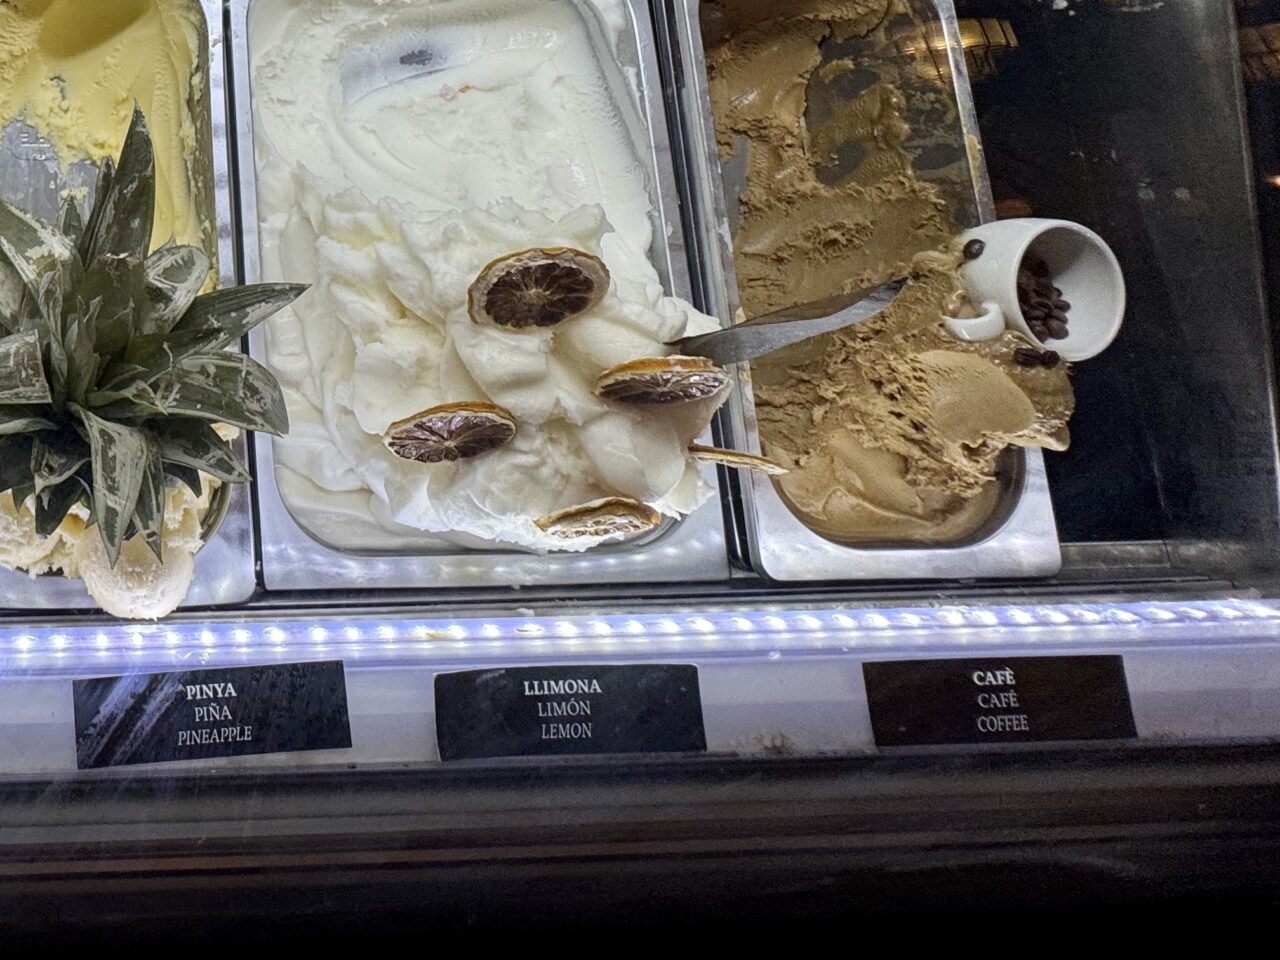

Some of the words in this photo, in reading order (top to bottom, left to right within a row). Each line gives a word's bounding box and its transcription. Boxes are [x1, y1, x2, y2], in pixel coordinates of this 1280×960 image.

[972, 667, 1016, 686] CAFÈ
[185, 682, 238, 701] PINYA
[523, 678, 603, 696] LLIMONA
[537, 697, 592, 717] LIMÓN
[977, 690, 1020, 709] CAFÉ
[194, 702, 233, 722] PIÑA
[540, 721, 593, 740] LEMON
[977, 714, 1030, 733] COFFEE
[177, 725, 253, 746] PINEAPPLE
